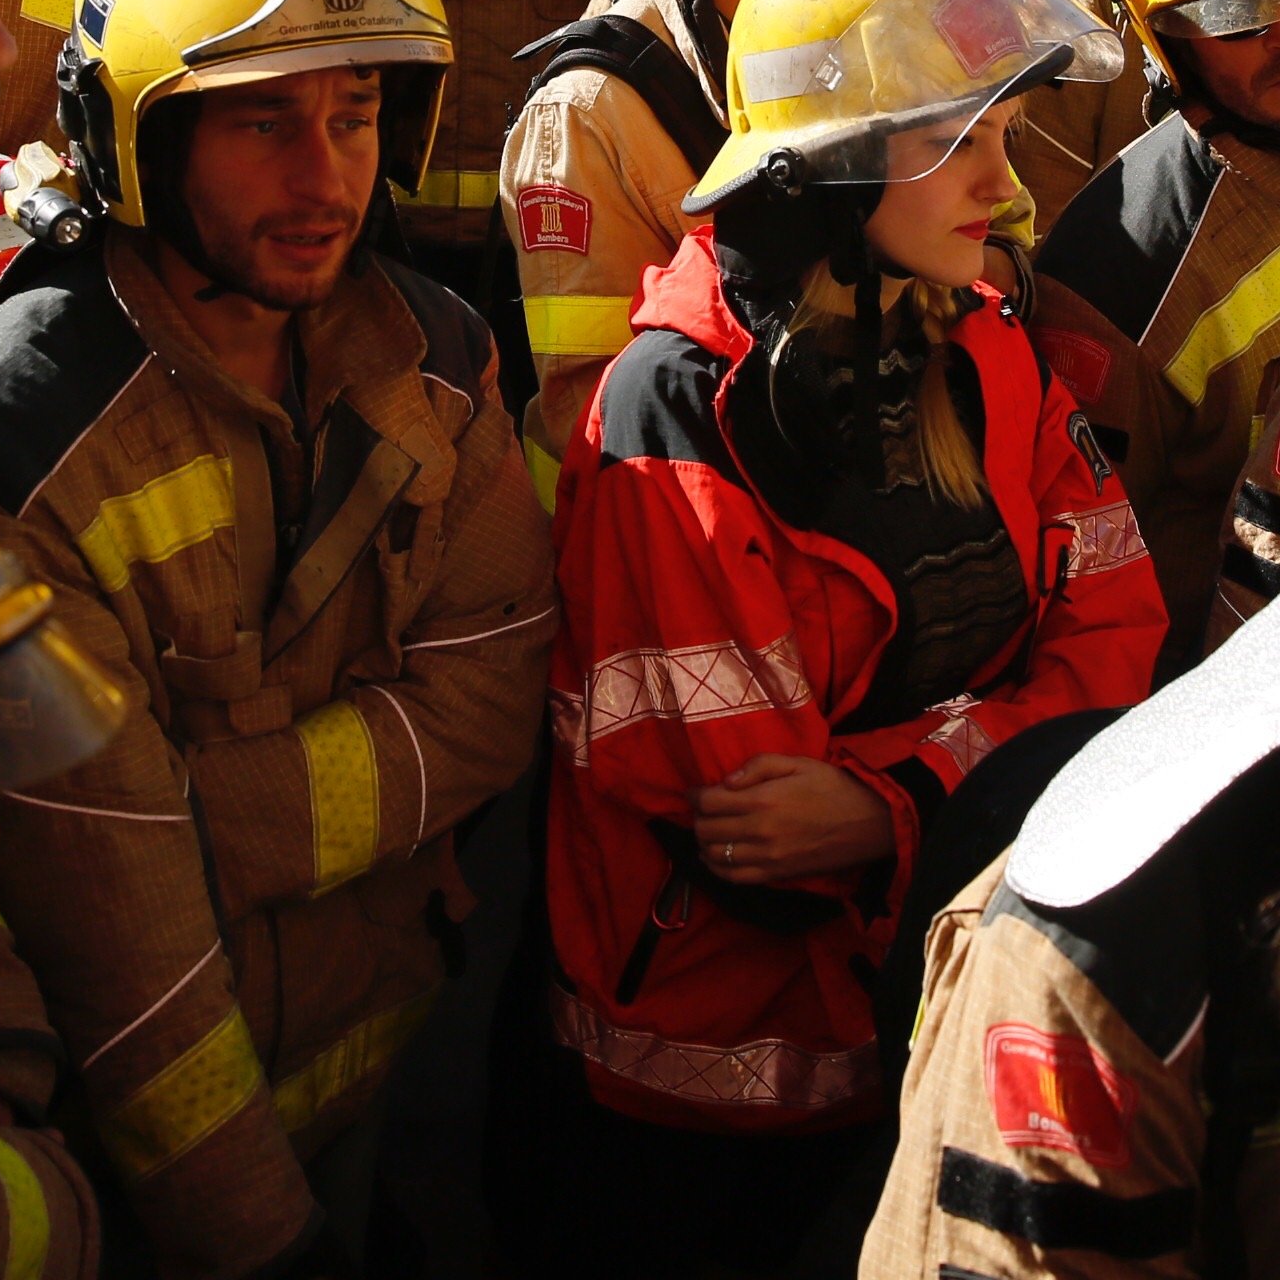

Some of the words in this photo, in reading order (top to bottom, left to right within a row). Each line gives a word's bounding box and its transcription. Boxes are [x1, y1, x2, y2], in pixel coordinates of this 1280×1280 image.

[279, 18, 341, 35] Generalitat
[344, 17, 357, 28] de
[358, 15, 404, 30] Catalunya
[537, 233, 569, 244] Bombers
